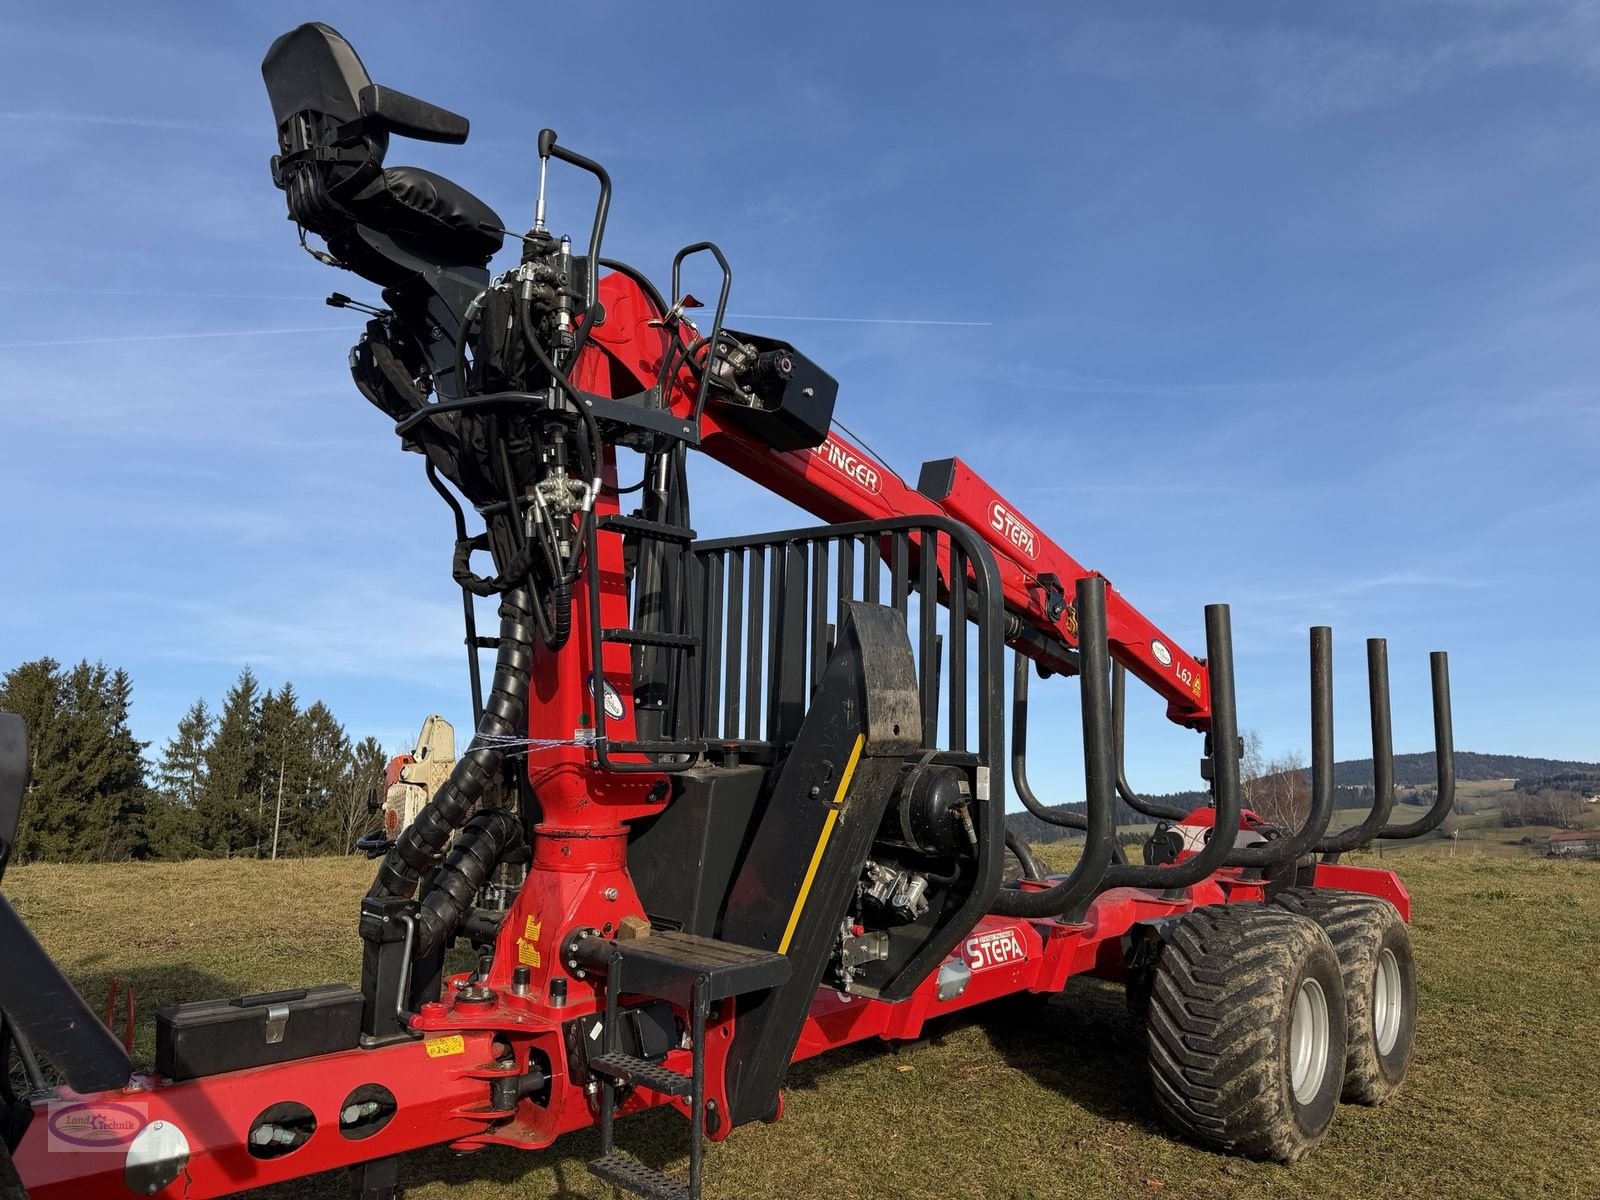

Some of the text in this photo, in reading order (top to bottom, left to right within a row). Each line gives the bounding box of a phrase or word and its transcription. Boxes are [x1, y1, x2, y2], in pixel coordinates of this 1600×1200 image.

[812, 440, 877, 491] FINGER
[992, 504, 1034, 557] STEPA
[1176, 662, 1191, 686] L62
[967, 936, 1023, 968] STEPA
